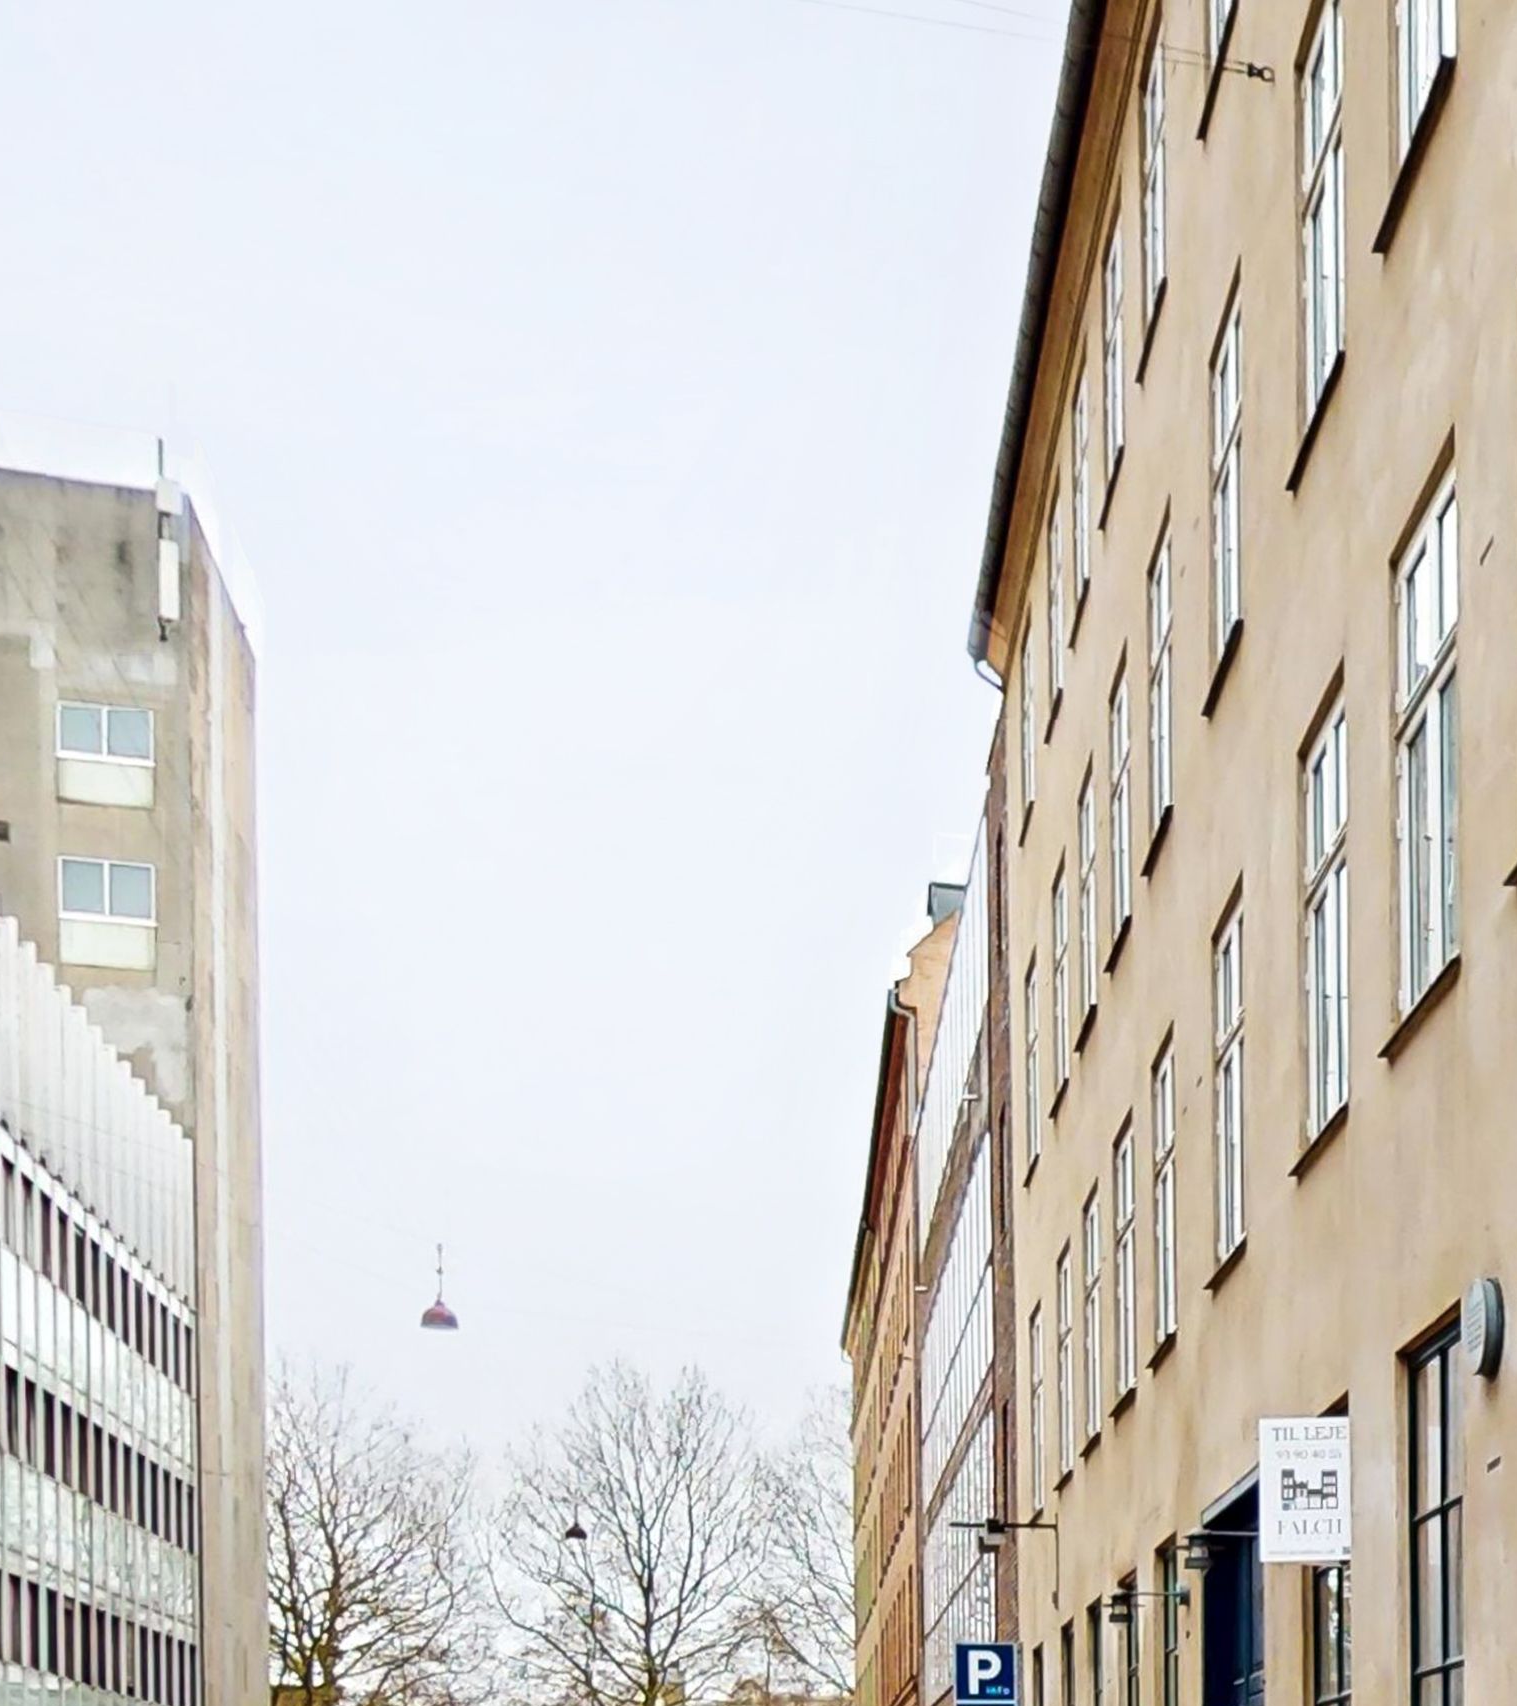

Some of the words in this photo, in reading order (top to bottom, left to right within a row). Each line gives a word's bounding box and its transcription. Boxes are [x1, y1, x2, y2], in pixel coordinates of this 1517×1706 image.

[1271, 1427, 1300, 1442] TIL
[1304, 1425, 1348, 1441] LEJE
[968, 1650, 1002, 1695] P
